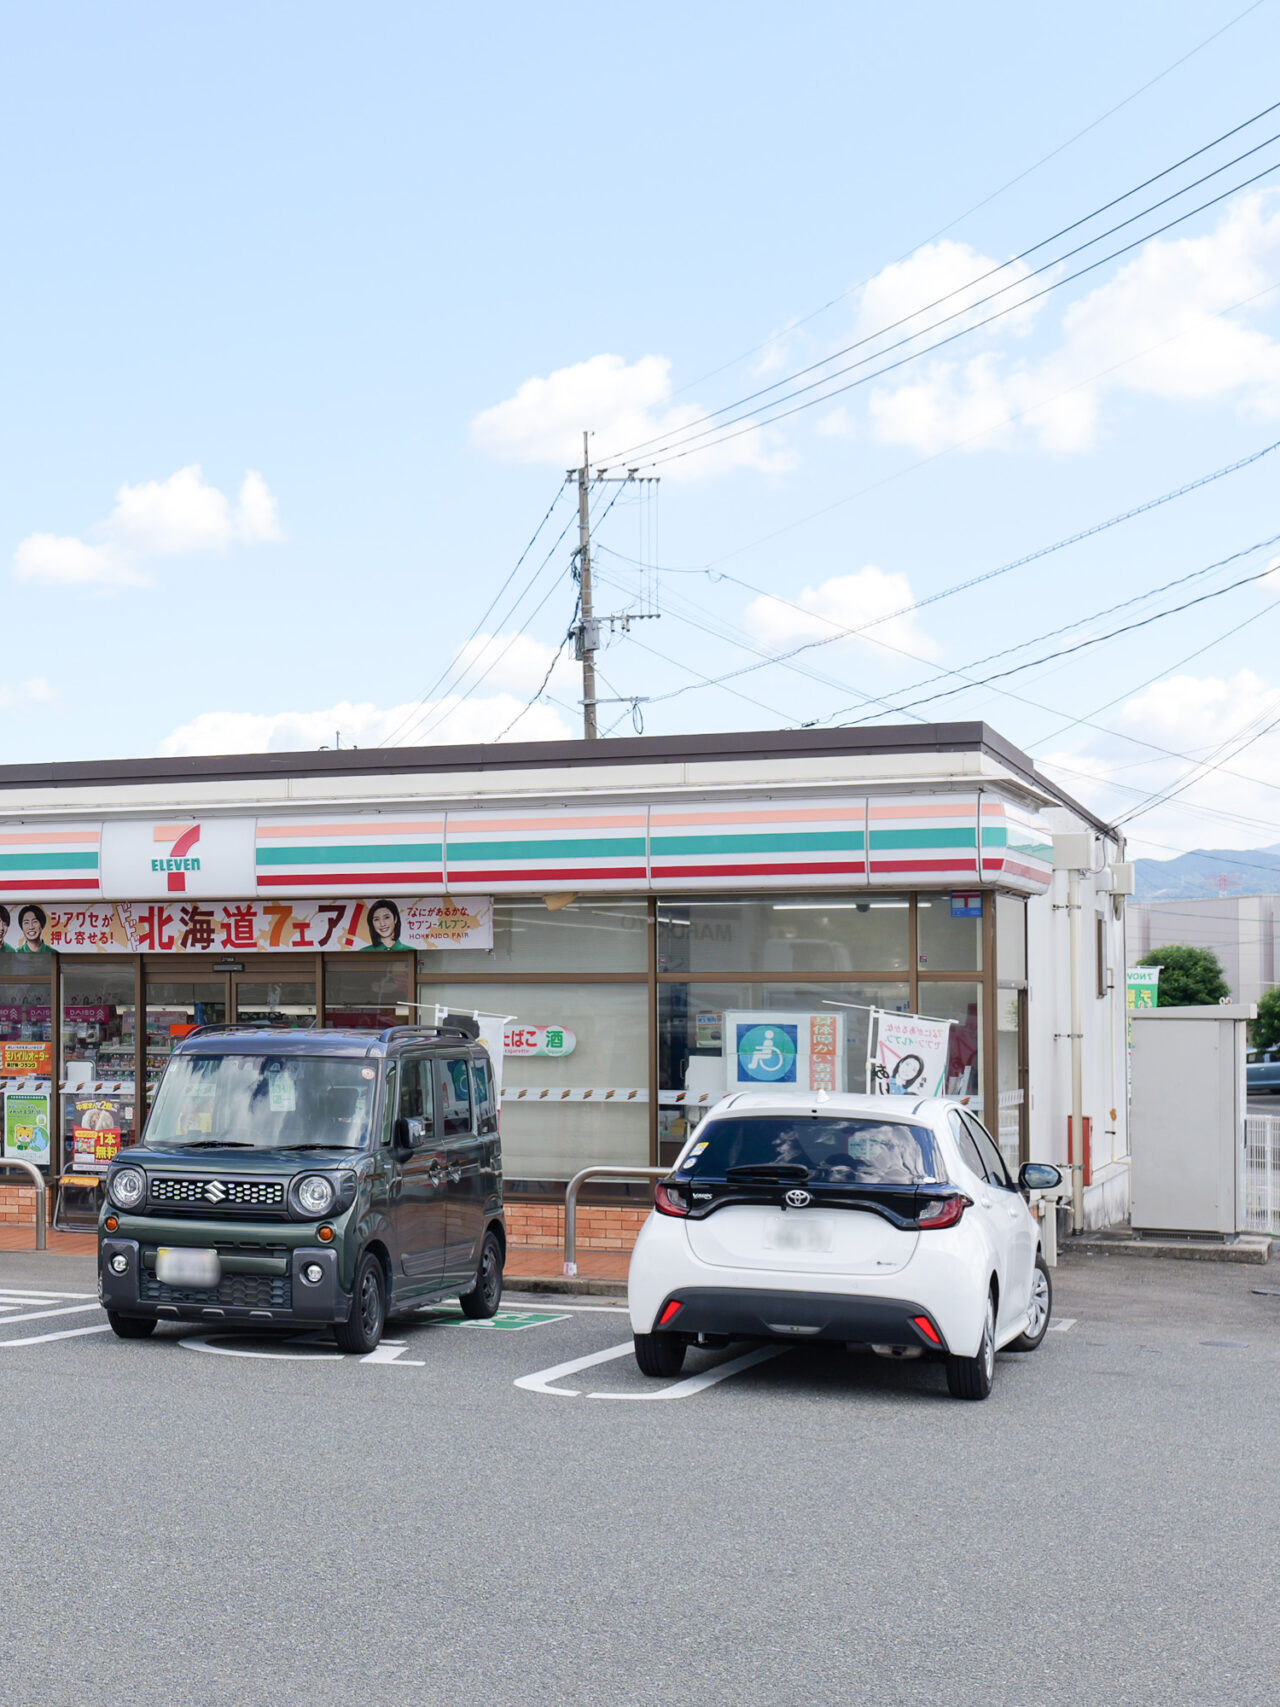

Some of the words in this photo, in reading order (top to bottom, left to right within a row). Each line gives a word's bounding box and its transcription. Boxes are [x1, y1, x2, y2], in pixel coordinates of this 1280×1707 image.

[50, 911, 114, 928] シアワセが
[50, 931, 114, 945] 押し寄せる!
[546, 1030, 564, 1049] 酒
[5, 1051, 49, 1062] モバイルオーダー
[98, 1132, 117, 1145] 1本
[95, 1146, 118, 1160] 無料
